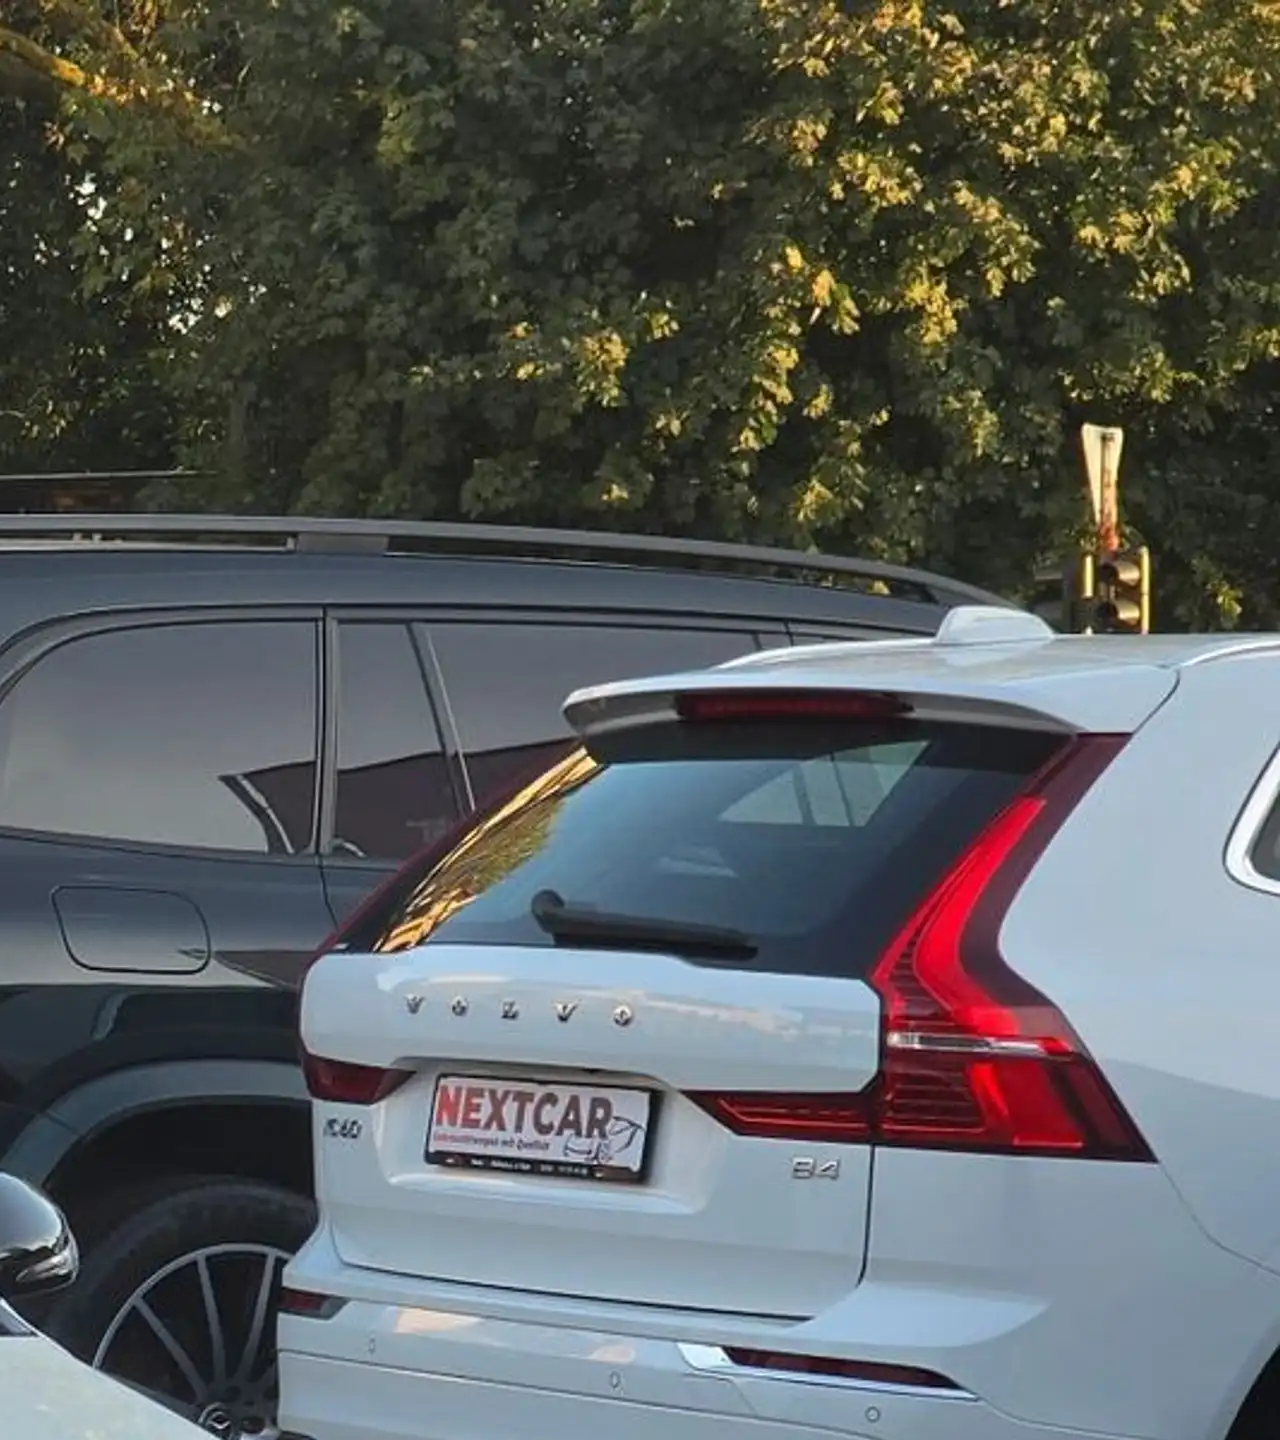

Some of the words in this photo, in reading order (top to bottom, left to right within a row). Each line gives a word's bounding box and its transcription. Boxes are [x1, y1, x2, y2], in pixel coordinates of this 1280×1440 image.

[406, 993, 634, 1027] VOLVO
[435, 1084, 613, 1140] NEXTCAR
[792, 1156, 840, 1181] B4
